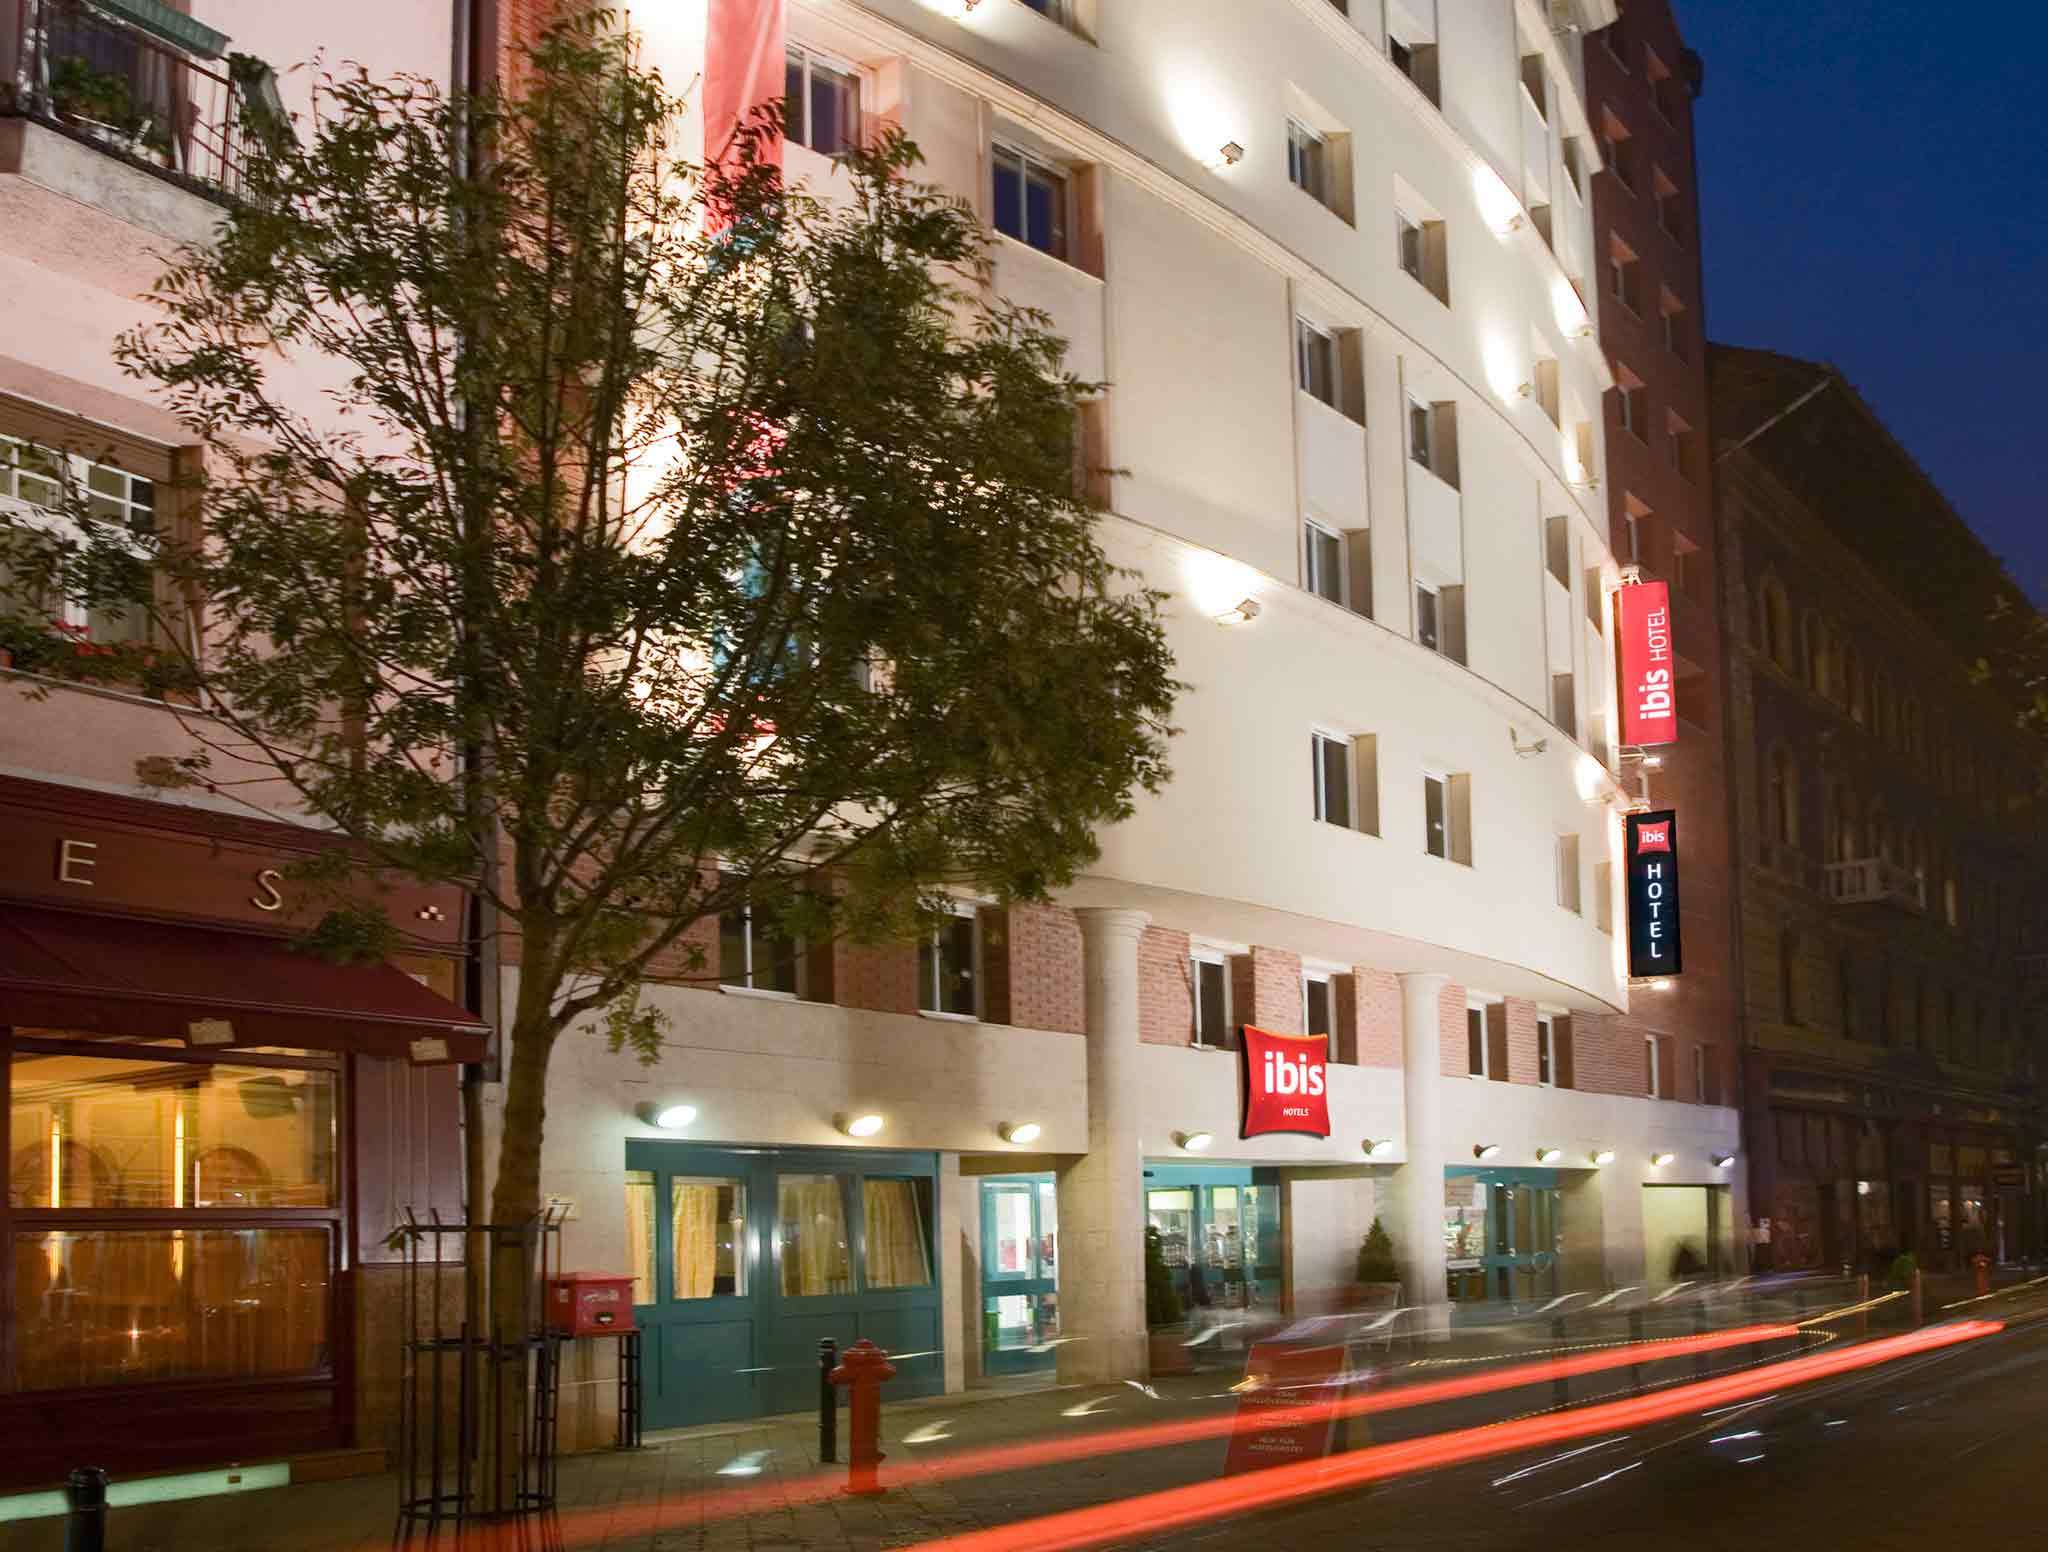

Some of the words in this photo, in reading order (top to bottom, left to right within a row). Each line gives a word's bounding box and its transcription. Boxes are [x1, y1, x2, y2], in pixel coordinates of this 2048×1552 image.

[1647, 607, 1668, 662] HOTEL
[1639, 667, 1671, 720] ibis
[1641, 830, 1665, 844] ibis
[1646, 863, 1663, 959] HOTEL
[1264, 1050, 1325, 1096] ibis
[1282, 1107, 1310, 1117] HOTELS
